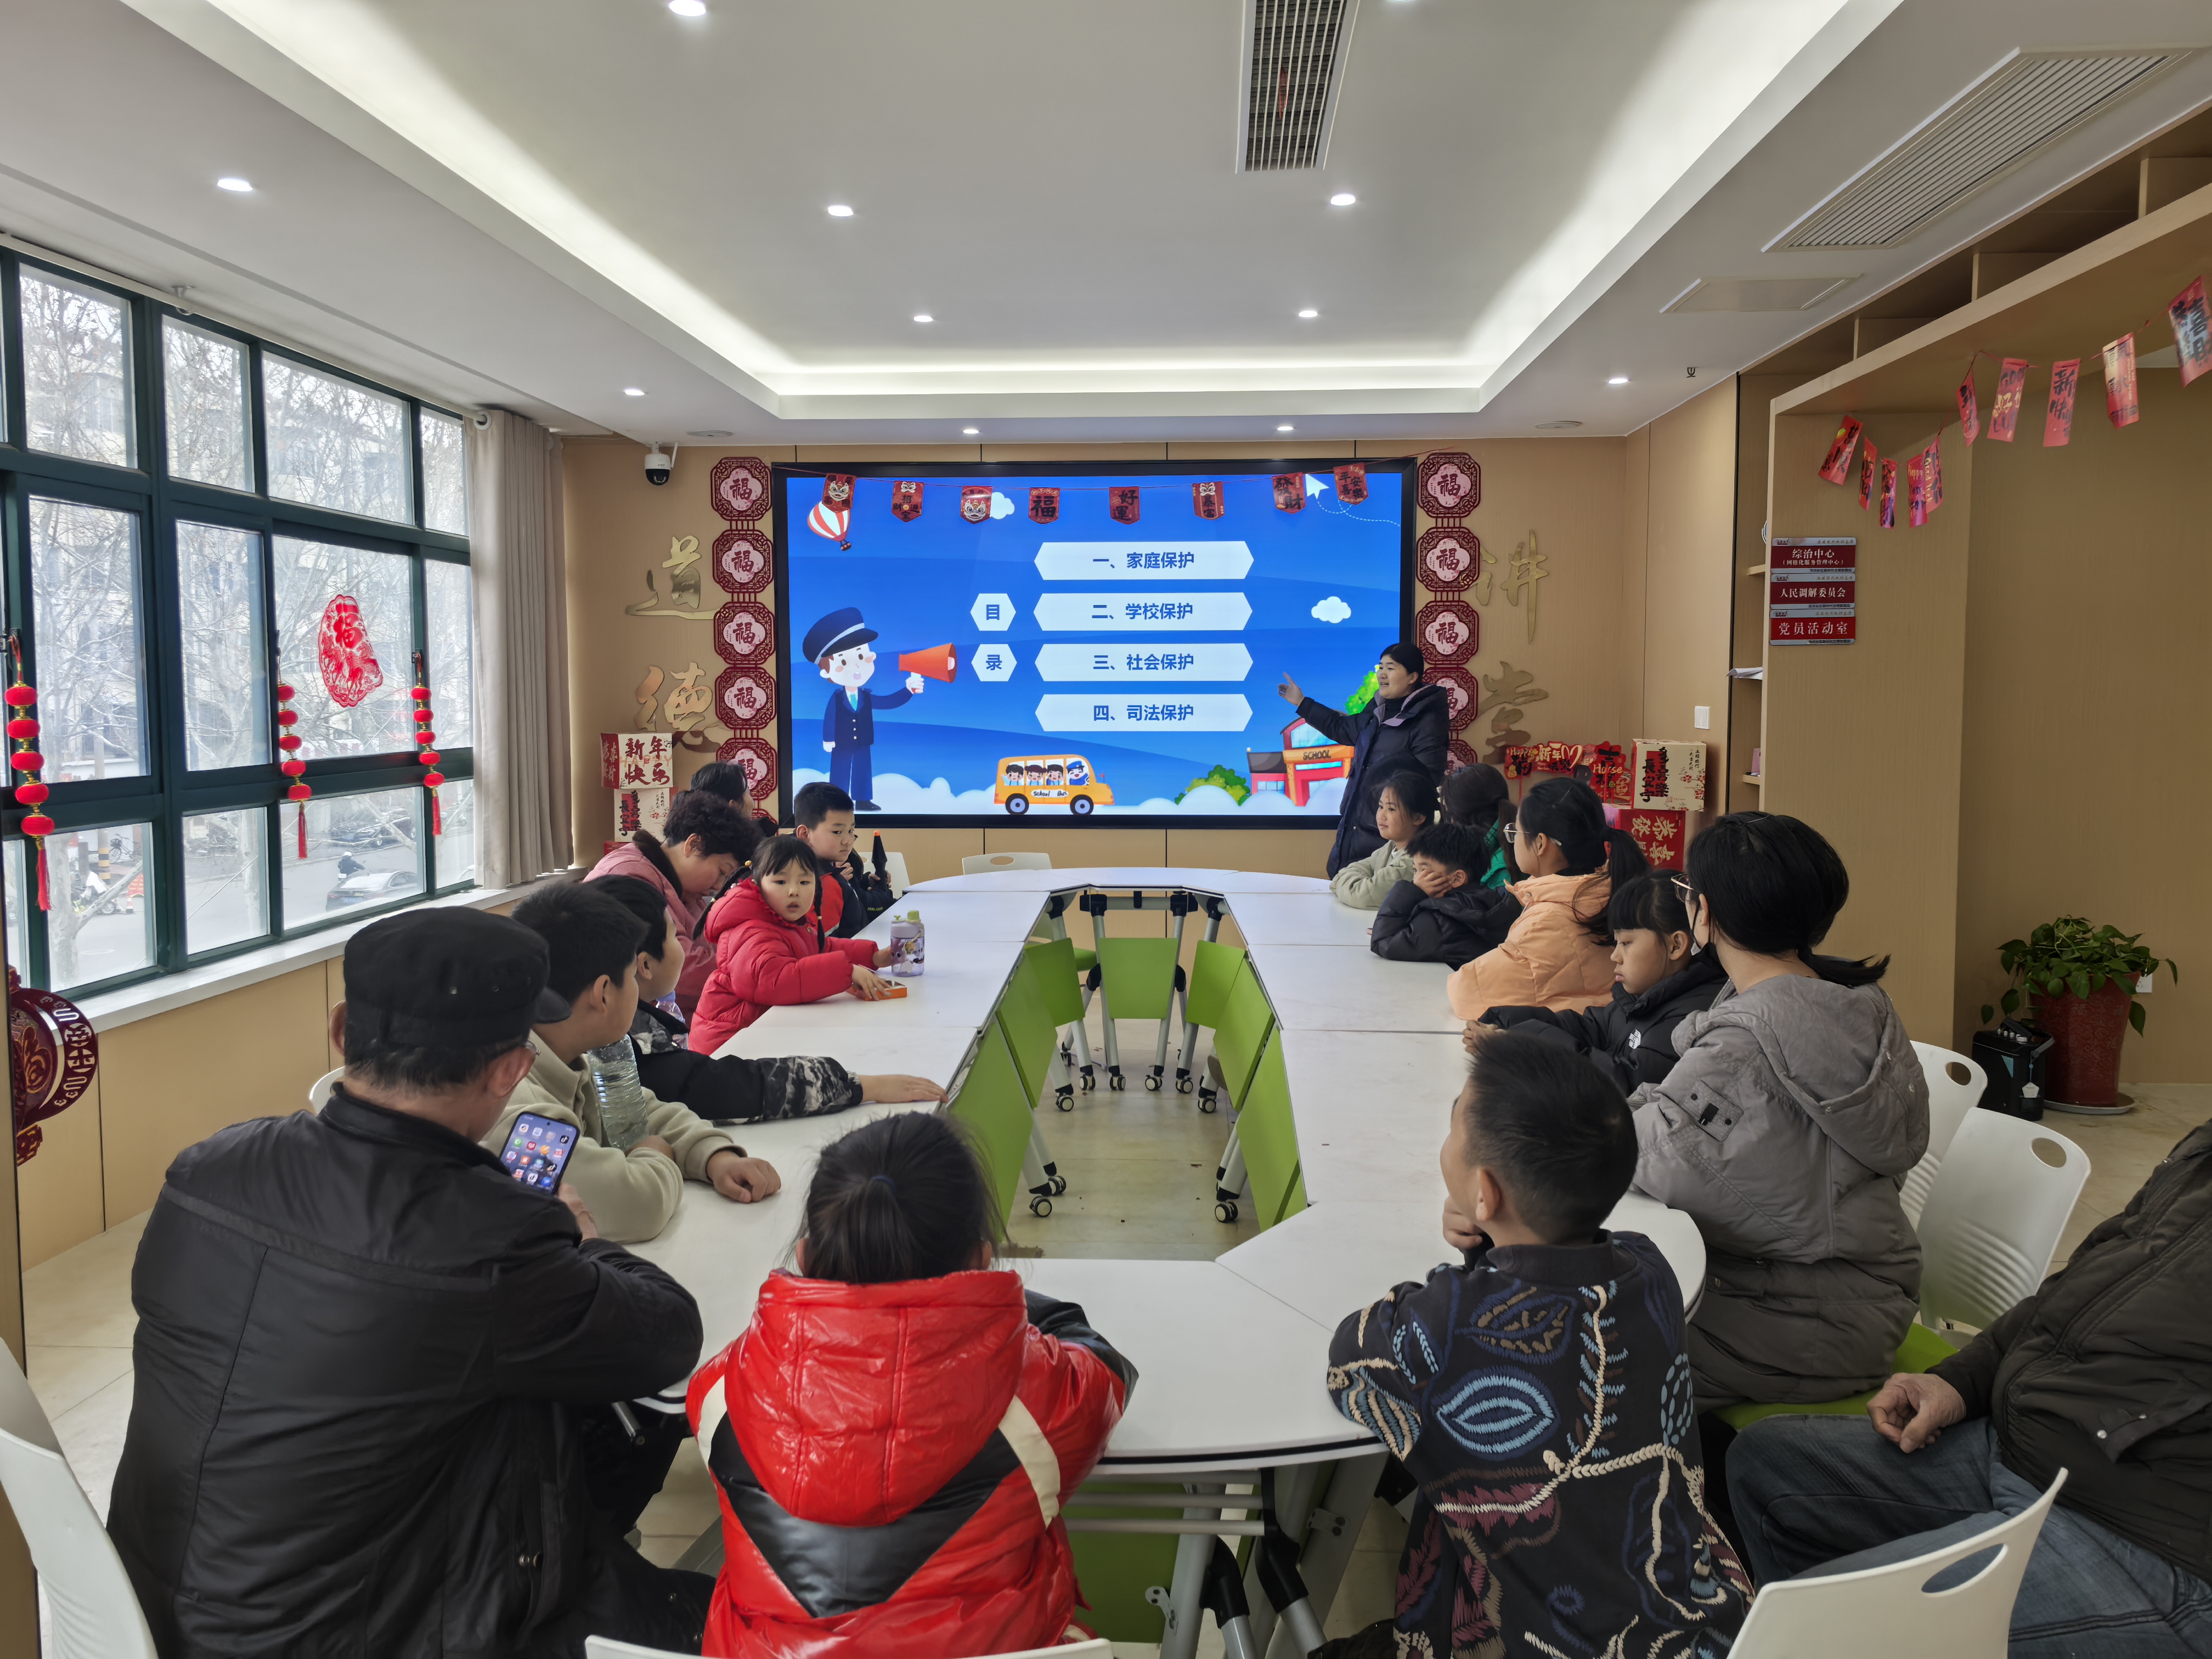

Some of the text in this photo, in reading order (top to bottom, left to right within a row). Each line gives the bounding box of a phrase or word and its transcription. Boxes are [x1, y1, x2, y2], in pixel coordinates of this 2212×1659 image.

[730, 478, 752, 501] 福
[1438, 474, 1461, 496] 福
[1031, 496, 1056, 517] 福
[731, 550, 754, 572] 福
[1093, 552, 1194, 569] 一、家庭保护
[1437, 548, 1460, 571] 福
[1792, 549, 1835, 558] 综治中心
[1779, 587, 1846, 598] 人民调解委员会
[1092, 603, 1193, 620] 二、学校保护
[733, 622, 756, 644] 福
[1435, 622, 1458, 645] 福
[1779, 622, 1847, 636] 党员活动室
[1093, 653, 1194, 670] 三、社会保护
[734, 687, 757, 709] 福
[1094, 704, 1194, 721] 四、司法保护
[625, 736, 667, 760] 新年
[1303, 750, 1331, 760] SCHOOL
